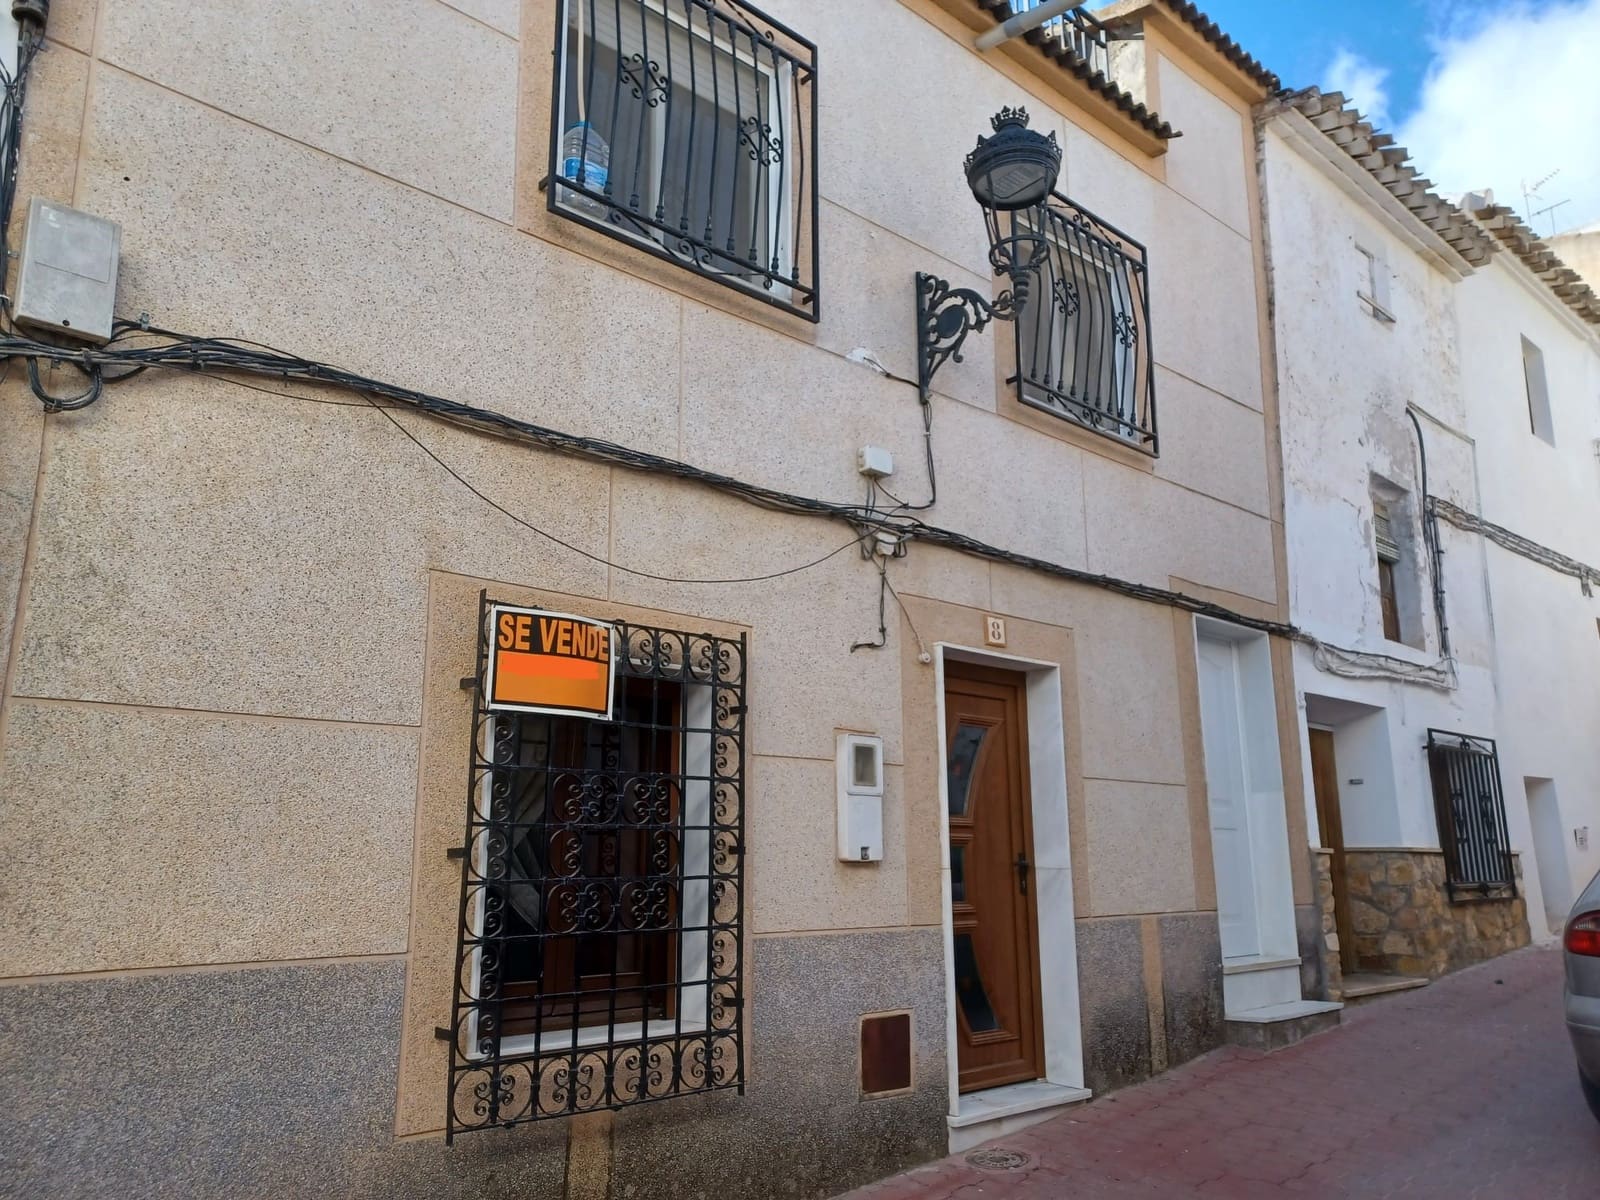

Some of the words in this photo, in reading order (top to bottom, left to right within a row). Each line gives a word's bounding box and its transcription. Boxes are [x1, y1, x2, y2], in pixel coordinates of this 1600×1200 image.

[498, 614, 532, 650] SE
[540, 618, 608, 661] VENDE
[991, 621, 1002, 640] 8
